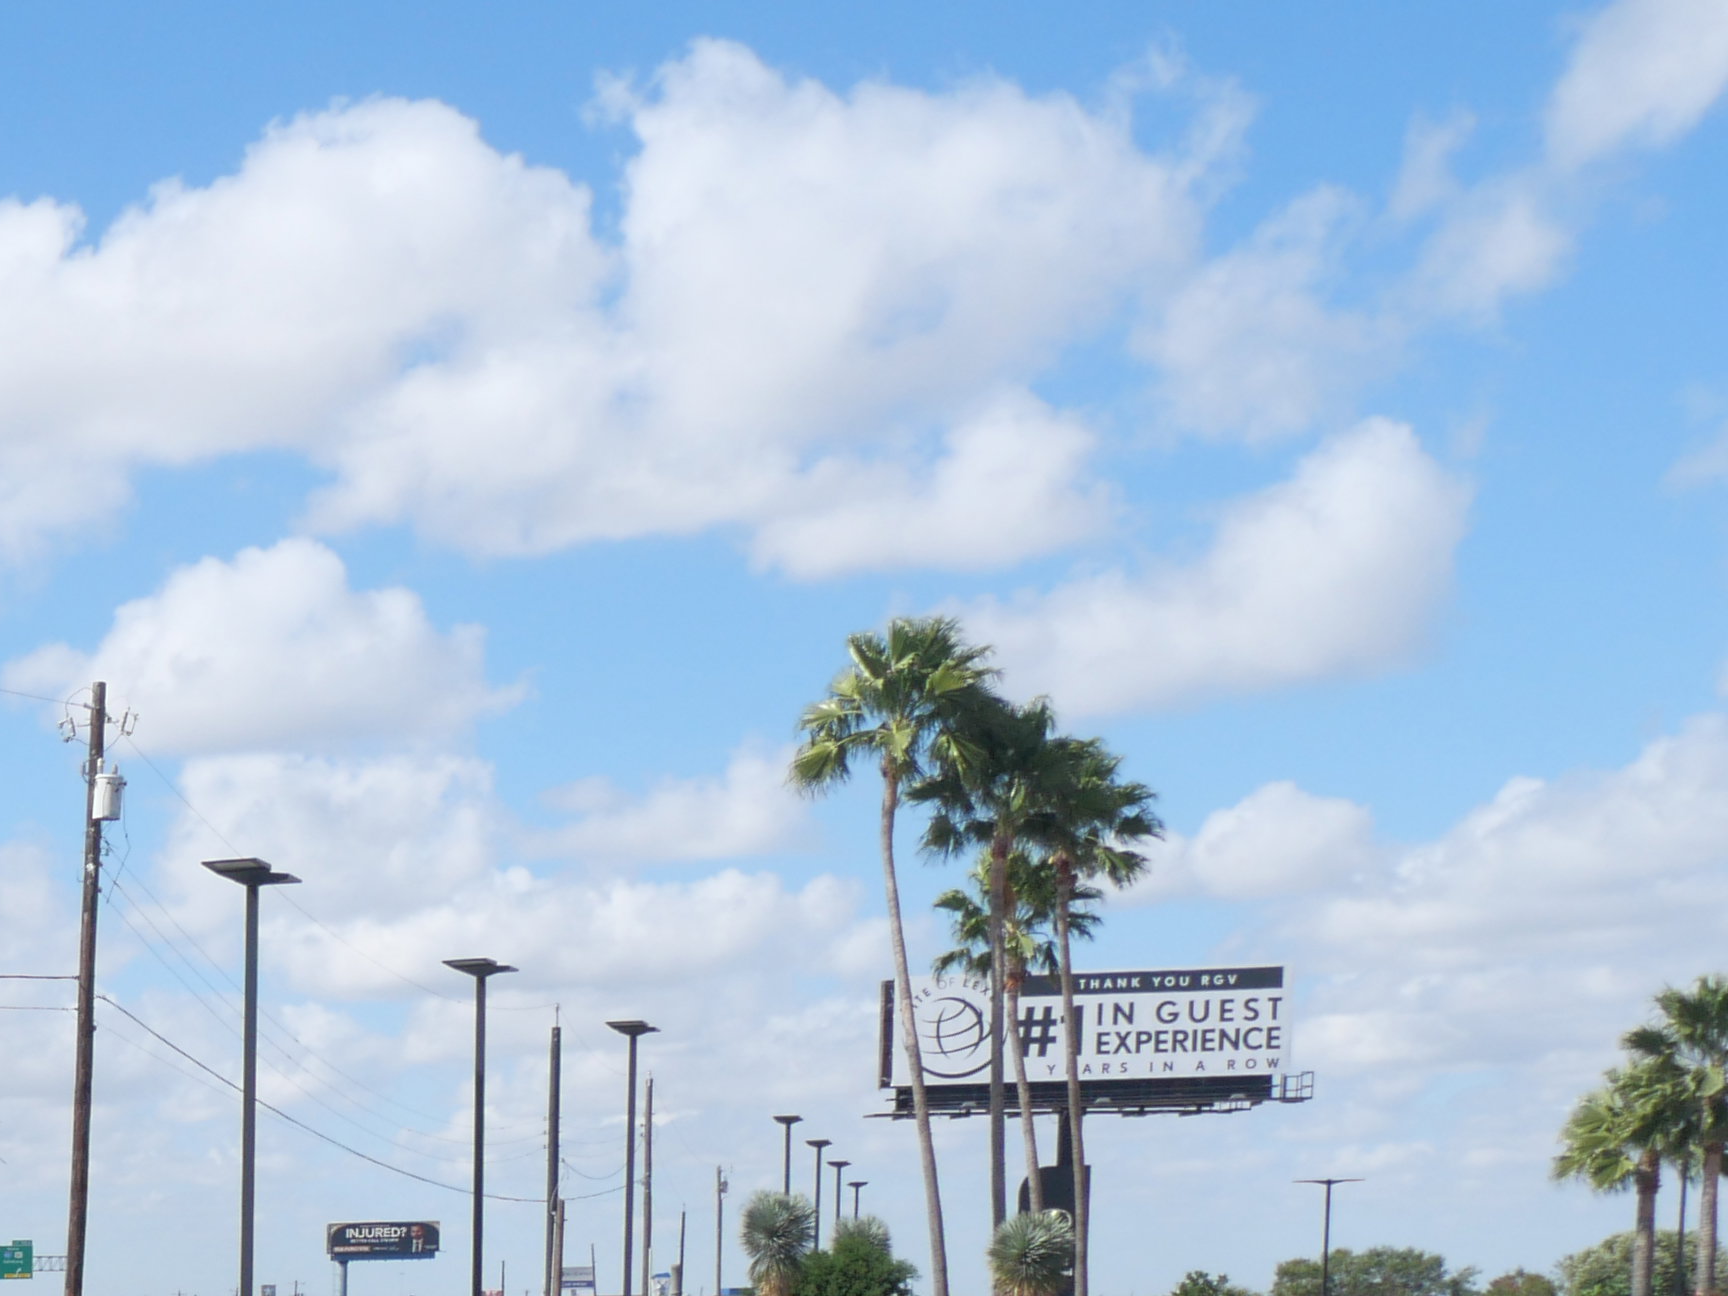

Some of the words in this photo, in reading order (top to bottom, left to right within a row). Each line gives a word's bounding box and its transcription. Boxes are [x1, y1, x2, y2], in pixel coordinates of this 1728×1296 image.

[1079, 977, 1141, 990] THANK
[1152, 975, 1191, 988] YOU
[1200, 974, 1239, 986] RGV
[1097, 1001, 1134, 1026] IN
[1155, 997, 1283, 1025] GUEST
[1016, 1005, 1084, 1057] #1
[1096, 1026, 1282, 1055] EXPERIENCE
[1047, 1062, 1128, 1075] YARS
[1149, 1061, 1174, 1073] IN
[1195, 1060, 1206, 1072] A
[1227, 1058, 1280, 1071] ROW
[346, 1227, 407, 1239] INJURED?
